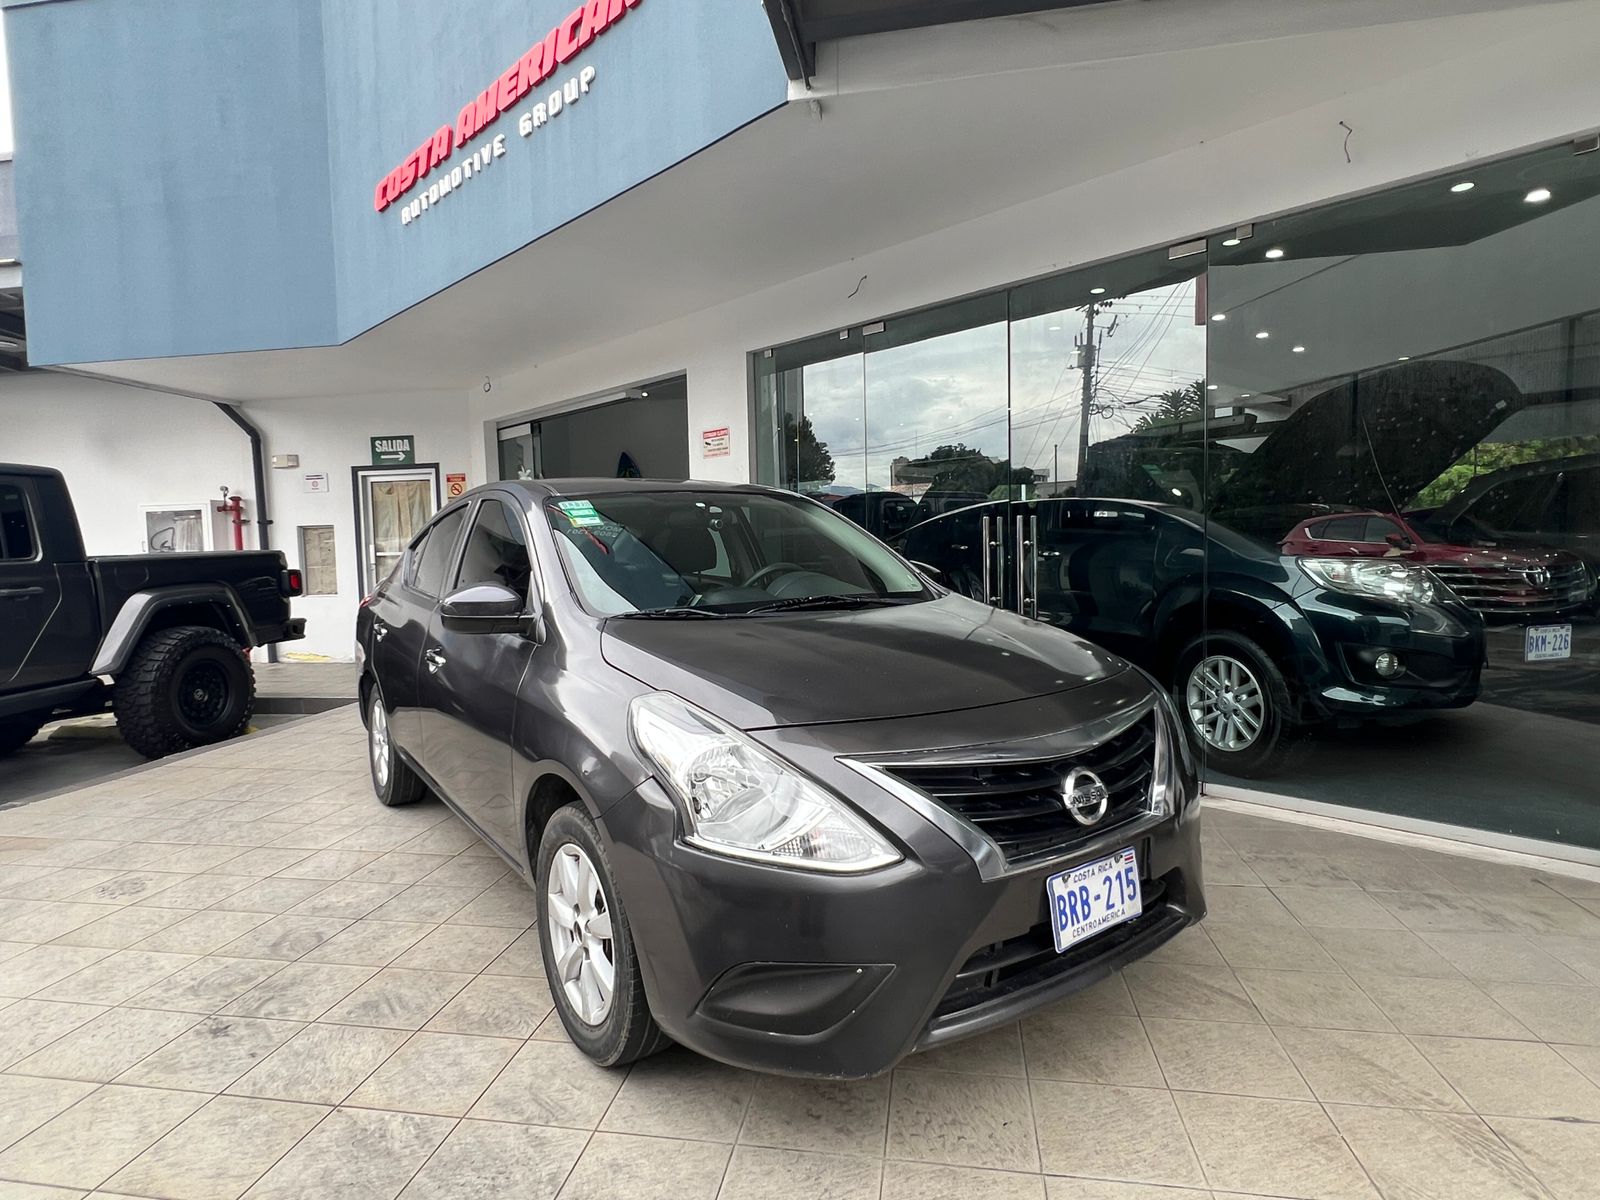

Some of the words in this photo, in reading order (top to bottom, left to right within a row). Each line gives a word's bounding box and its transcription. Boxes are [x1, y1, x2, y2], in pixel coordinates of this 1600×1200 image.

[401, 133, 506, 226] AUTOMOTIVE
[518, 65, 596, 137] GROUP
[374, 124, 453, 213] COSTA
[375, 439, 410, 452] SALIDA
[1528, 633, 1569, 653] BKM-226
[1073, 868, 1096, 884] COSTA
[1098, 861, 1113, 874] RICA
[1056, 866, 1137, 932] BRB-215
[1072, 907, 1126, 938] CENTROAMERICA
